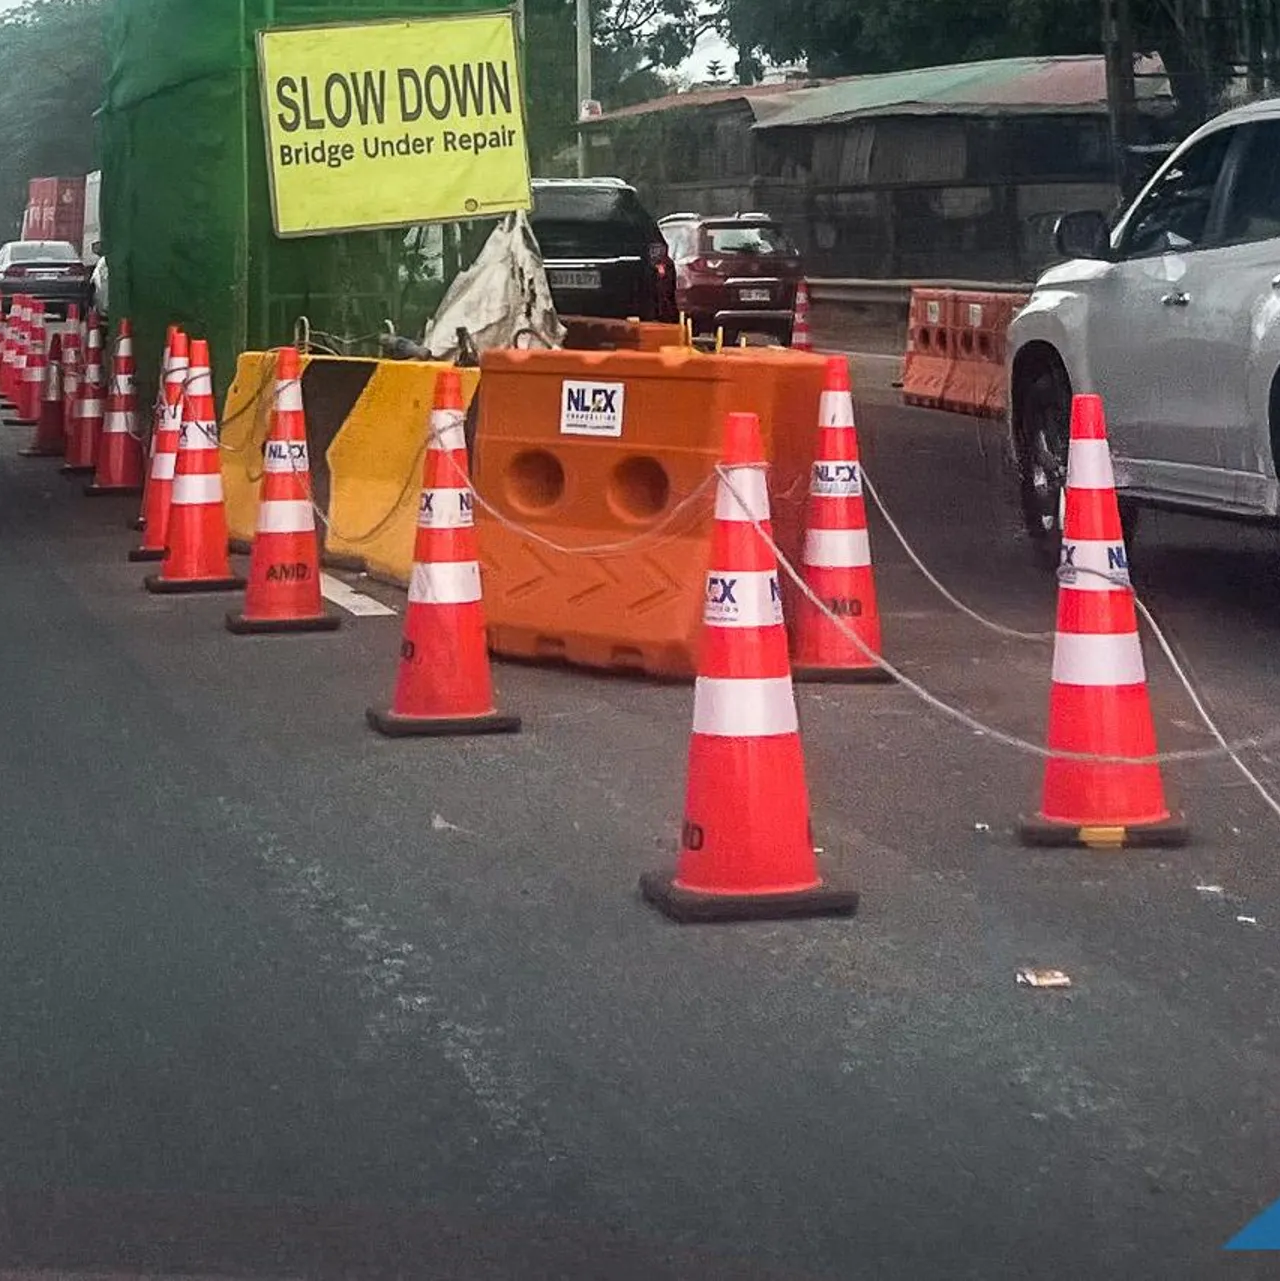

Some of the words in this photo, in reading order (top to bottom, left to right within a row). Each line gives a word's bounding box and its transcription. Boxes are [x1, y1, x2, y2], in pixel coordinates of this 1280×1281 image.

[275, 70, 386, 133] SLOW
[397, 60, 513, 122] DOWN
[279, 140, 354, 169] Bridge
[363, 132, 435, 159] Under
[443, 124, 516, 155] Repair
[567, 387, 618, 414] NLEX
[813, 464, 859, 483] NLEX
